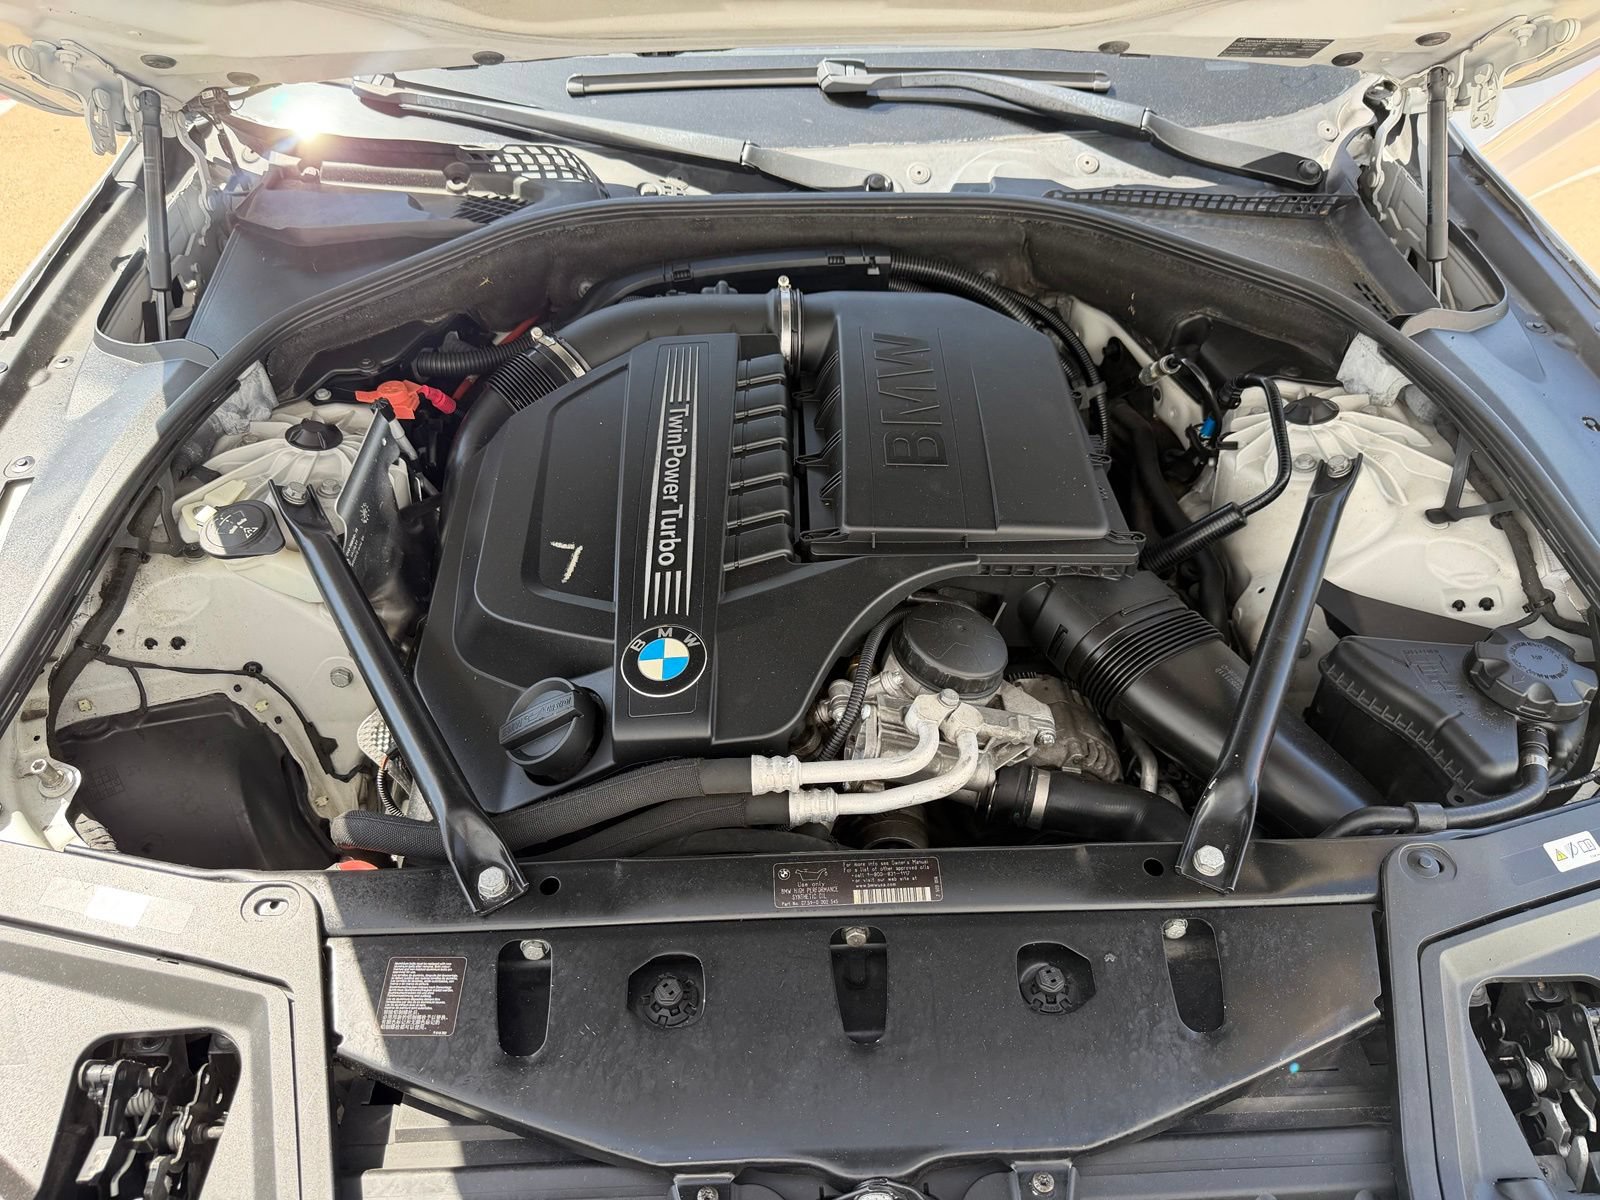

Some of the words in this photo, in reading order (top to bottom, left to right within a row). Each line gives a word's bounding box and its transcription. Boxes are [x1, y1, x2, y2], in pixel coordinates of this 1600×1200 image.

[872, 332, 949, 467] BMW
[662, 403, 690, 503] TwinPower
[658, 503, 684, 567] Turbo
[630, 627, 701, 652] BMW
